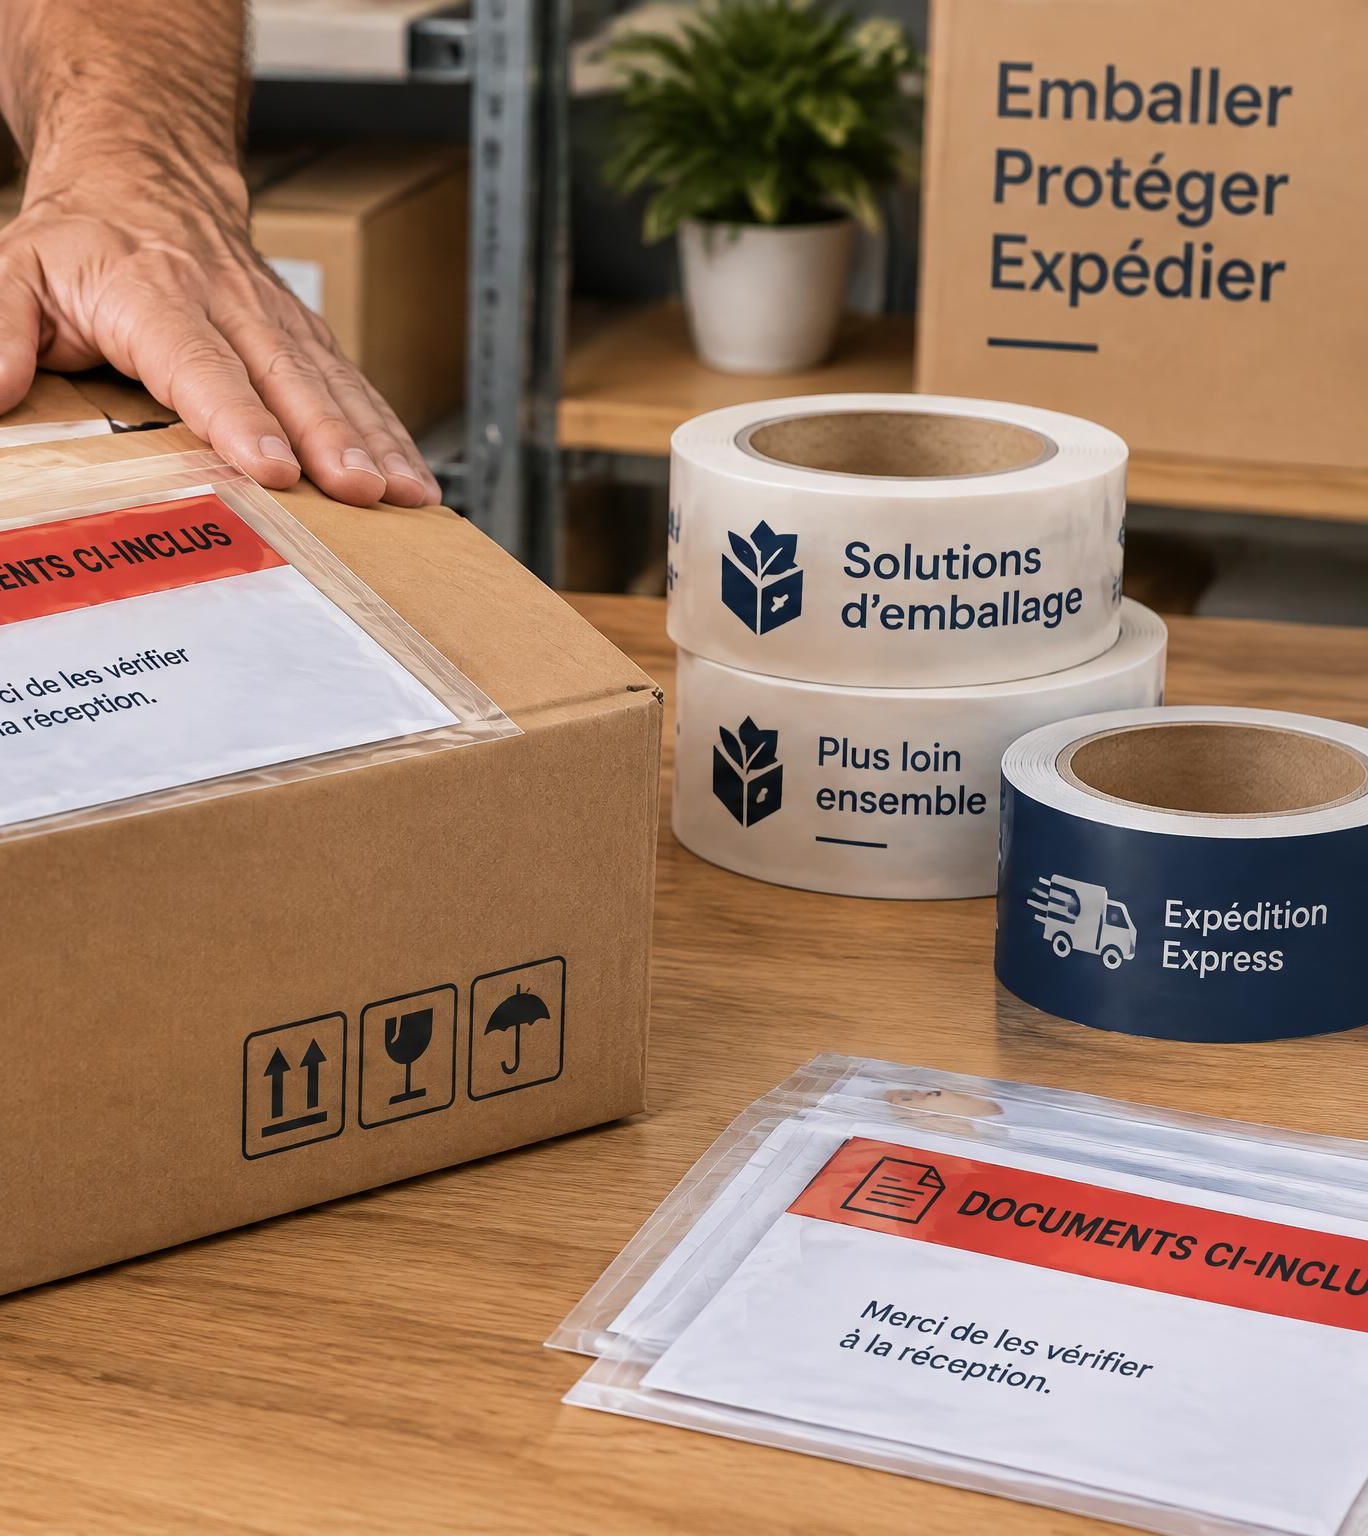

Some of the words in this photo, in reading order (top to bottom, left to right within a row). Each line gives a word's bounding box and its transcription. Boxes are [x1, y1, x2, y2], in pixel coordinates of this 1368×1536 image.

[998, 60, 1293, 127] Emballer
[993, 147, 1289, 228] Protéger
[991, 232, 1286, 308] Expédier
[72, 522, 232, 573] CI-INCLUS
[843, 541, 1042, 580] Solutions
[841, 587, 1083, 630] d'emballage
[25, 677, 62, 698] de
[59, 669, 103, 691] les
[103, 647, 190, 678] vérifier
[24, 689, 157, 731] réception.
[818, 735, 890, 771] Plus
[902, 741, 961, 772] loin
[815, 784, 987, 815] ensemble
[1165, 899, 1327, 937] Expédition
[1162, 939, 1284, 979] Express
[957, 1190, 1198, 1261] DOCUMENTS
[860, 1300, 949, 1336] Merci
[951, 1322, 989, 1346] de
[993, 1328, 1038, 1356] les
[1047, 1342, 1154, 1381] vérifier
[864, 1333, 893, 1358] la
[898, 1341, 1053, 1395] réception.
